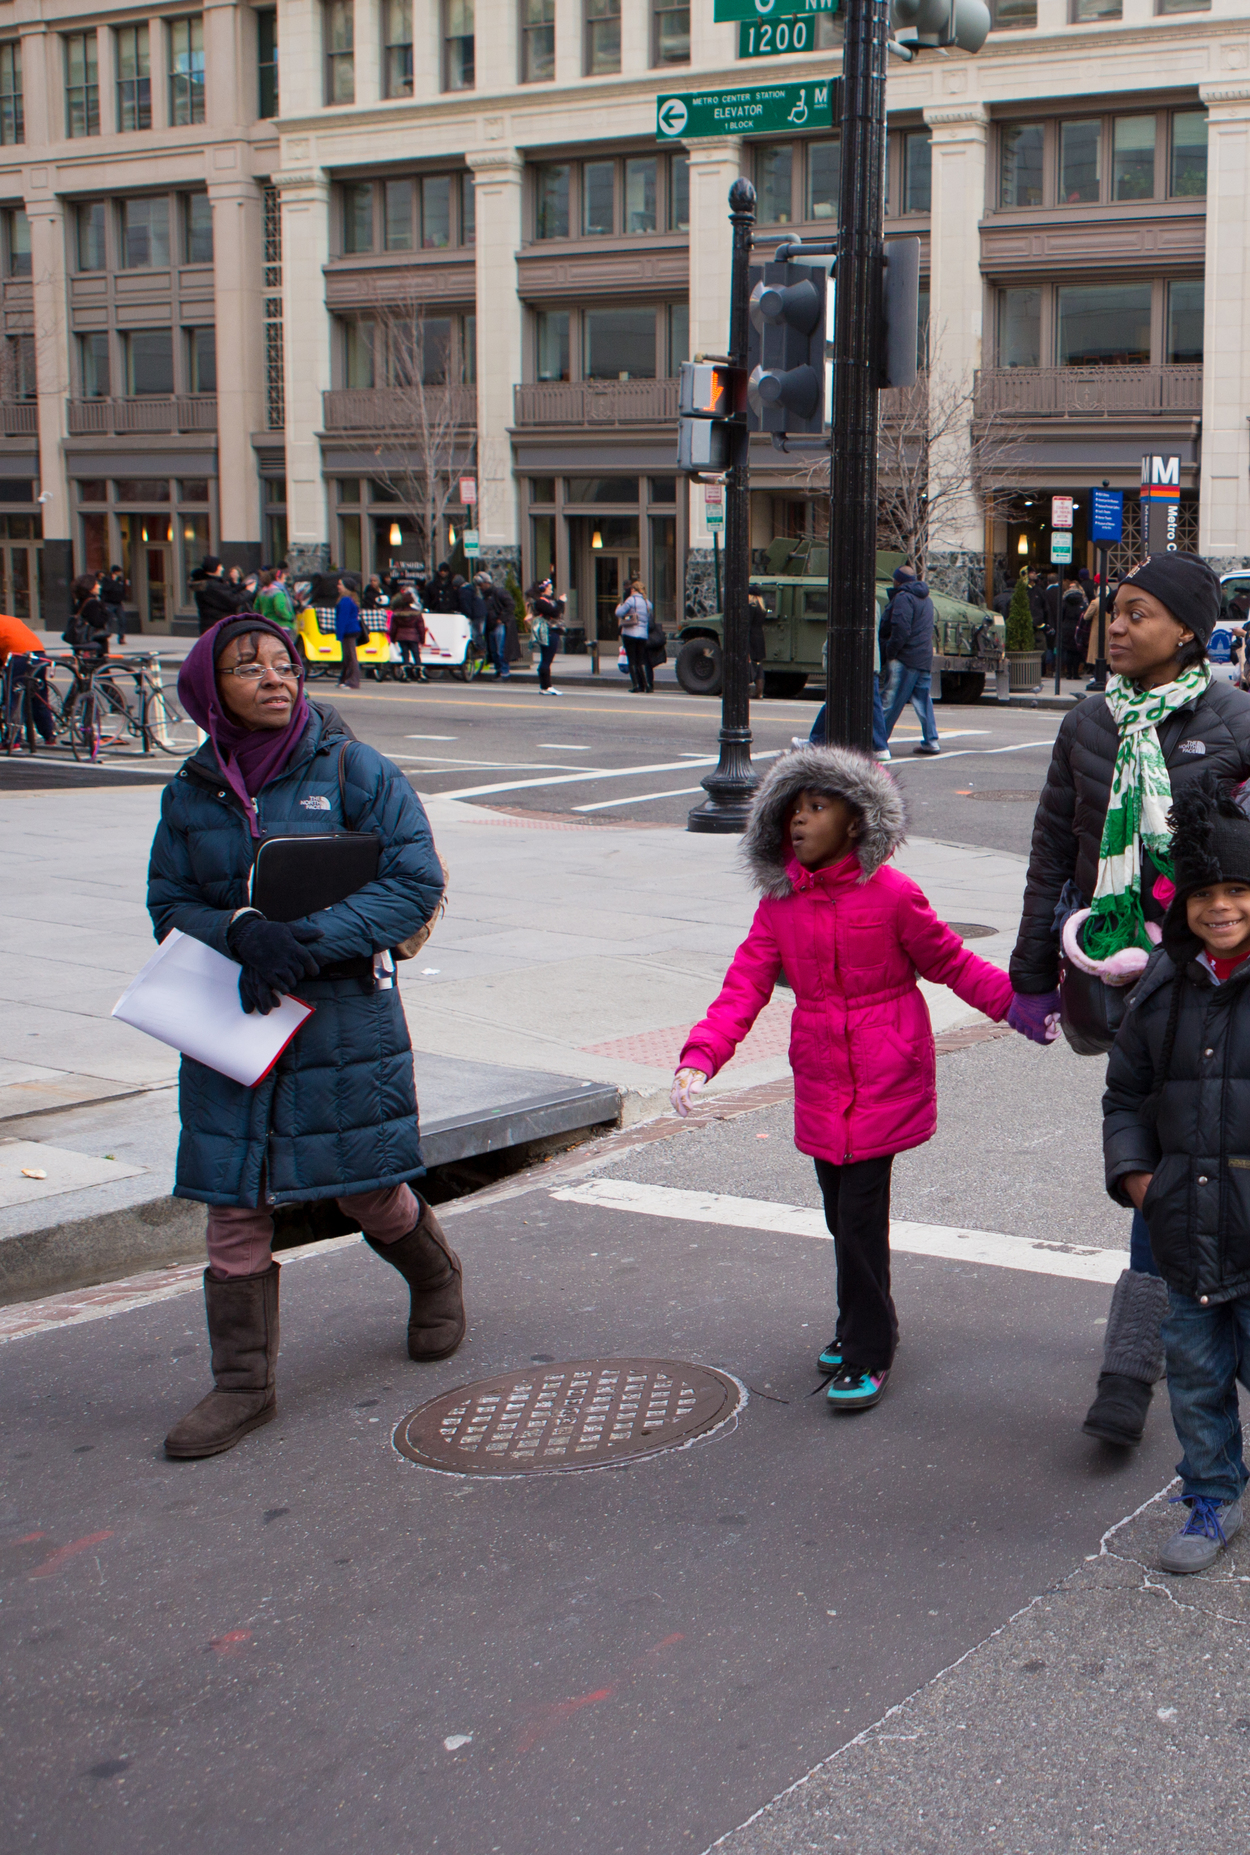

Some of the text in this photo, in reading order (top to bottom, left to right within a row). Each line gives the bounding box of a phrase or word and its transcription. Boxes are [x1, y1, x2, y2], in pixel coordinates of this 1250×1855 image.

[749, 22, 807, 54] 1200
[692, 90, 785, 106] METRO CENTER STATION
[814, 87, 828, 103] M
[714, 104, 763, 118] ELEVATOR
[730, 121, 754, 129] BLOCK
[1151, 456, 1179, 484] M
[1167, 506, 1178, 540] Metro
